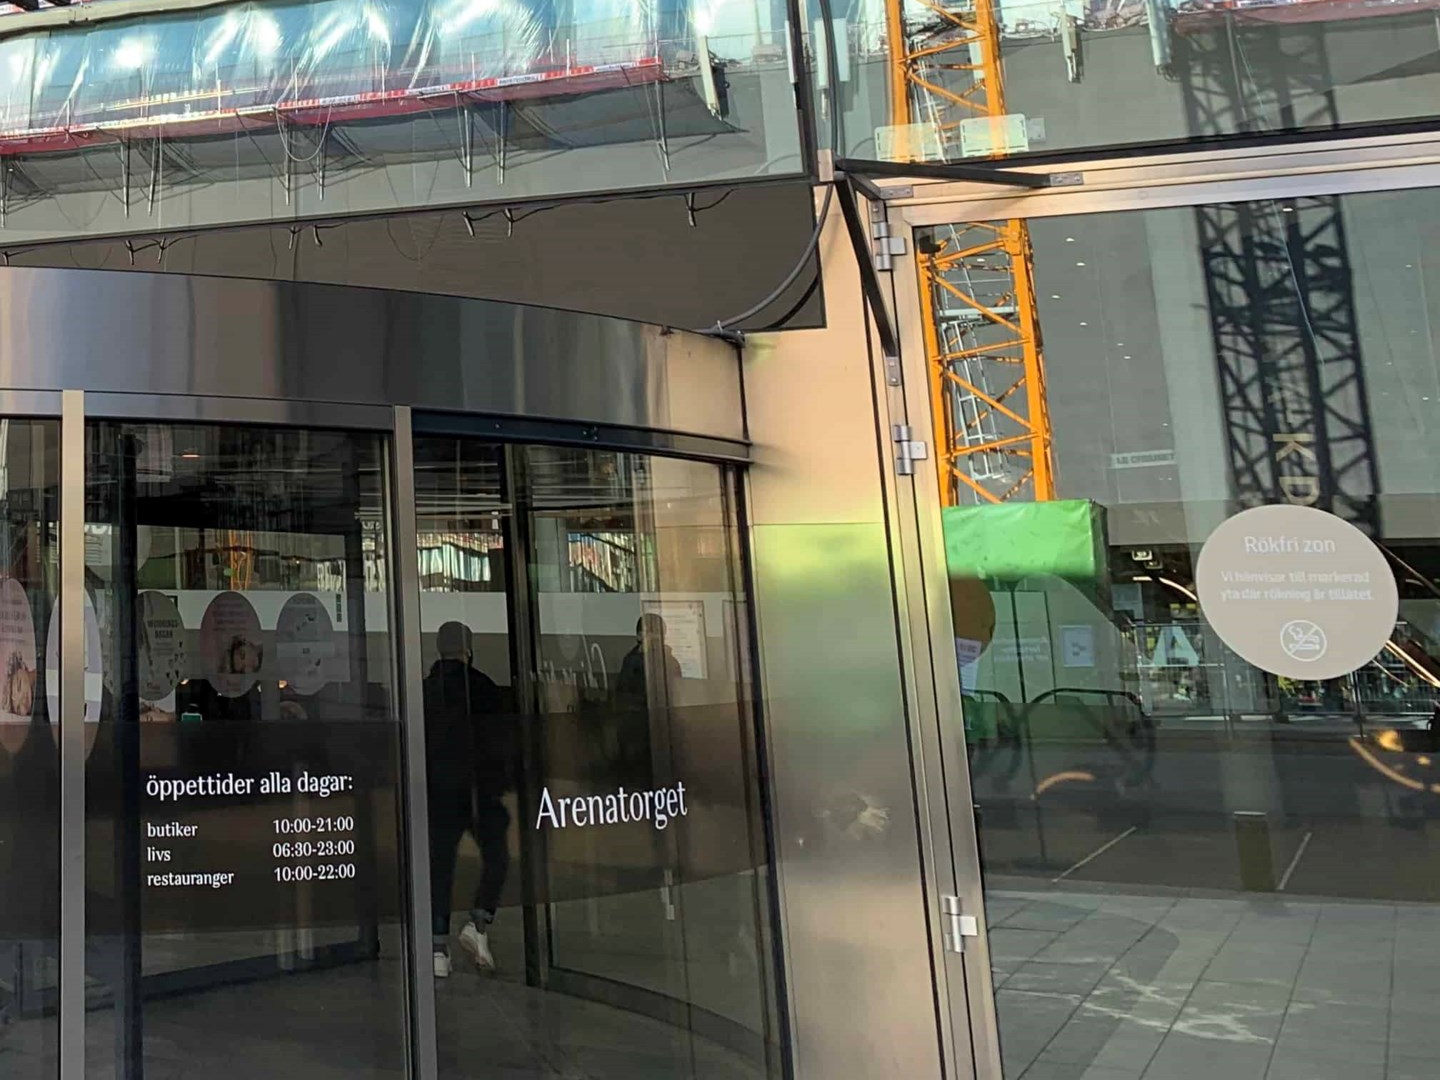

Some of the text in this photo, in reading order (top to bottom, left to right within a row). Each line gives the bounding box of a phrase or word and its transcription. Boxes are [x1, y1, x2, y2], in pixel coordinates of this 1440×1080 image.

[1244, 536, 1336, 554] Rökfri zon
[146, 770, 354, 803] öppettider alla dagar:
[535, 781, 688, 832] Arenatorget
[147, 816, 355, 838] butiker 10:00-21:00
[147, 840, 355, 863] livs 06:30-23:00
[147, 864, 356, 889] restauranger 10:00-22:00
